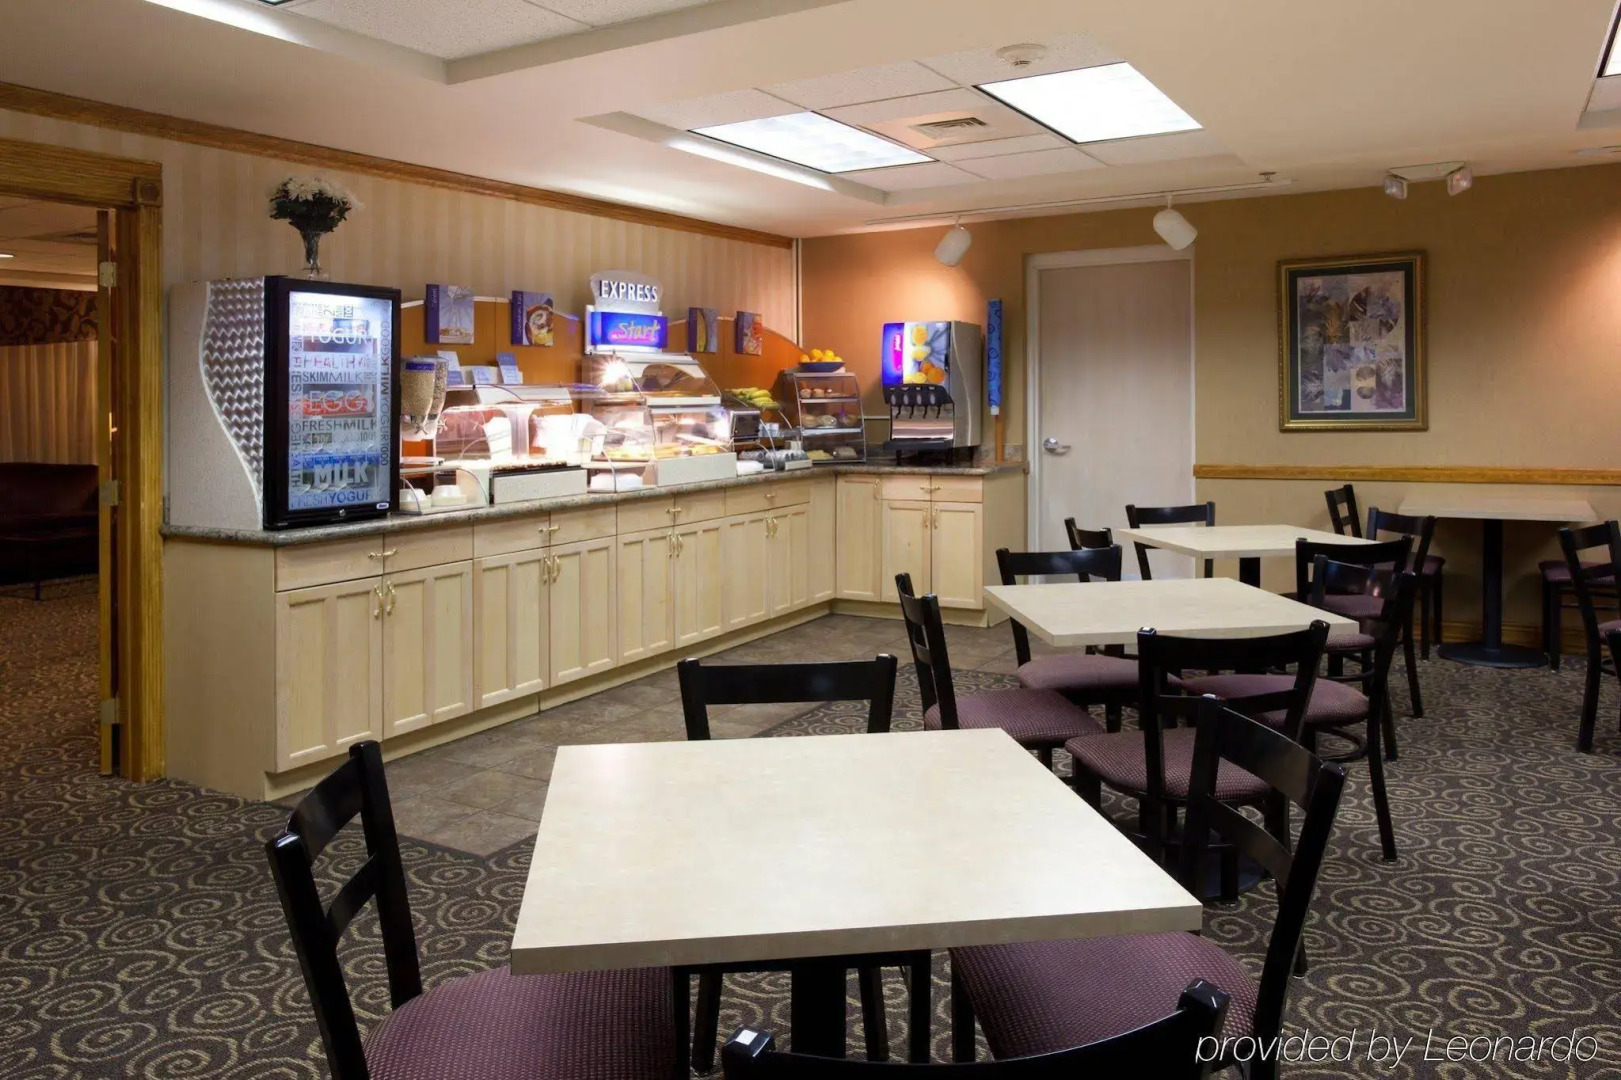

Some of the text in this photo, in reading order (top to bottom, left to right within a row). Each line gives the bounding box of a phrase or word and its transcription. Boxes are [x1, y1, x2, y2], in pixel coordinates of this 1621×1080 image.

[601, 280, 658, 302] EXPRESS
[618, 319, 661, 342] Start
[314, 461, 368, 488] MILK
